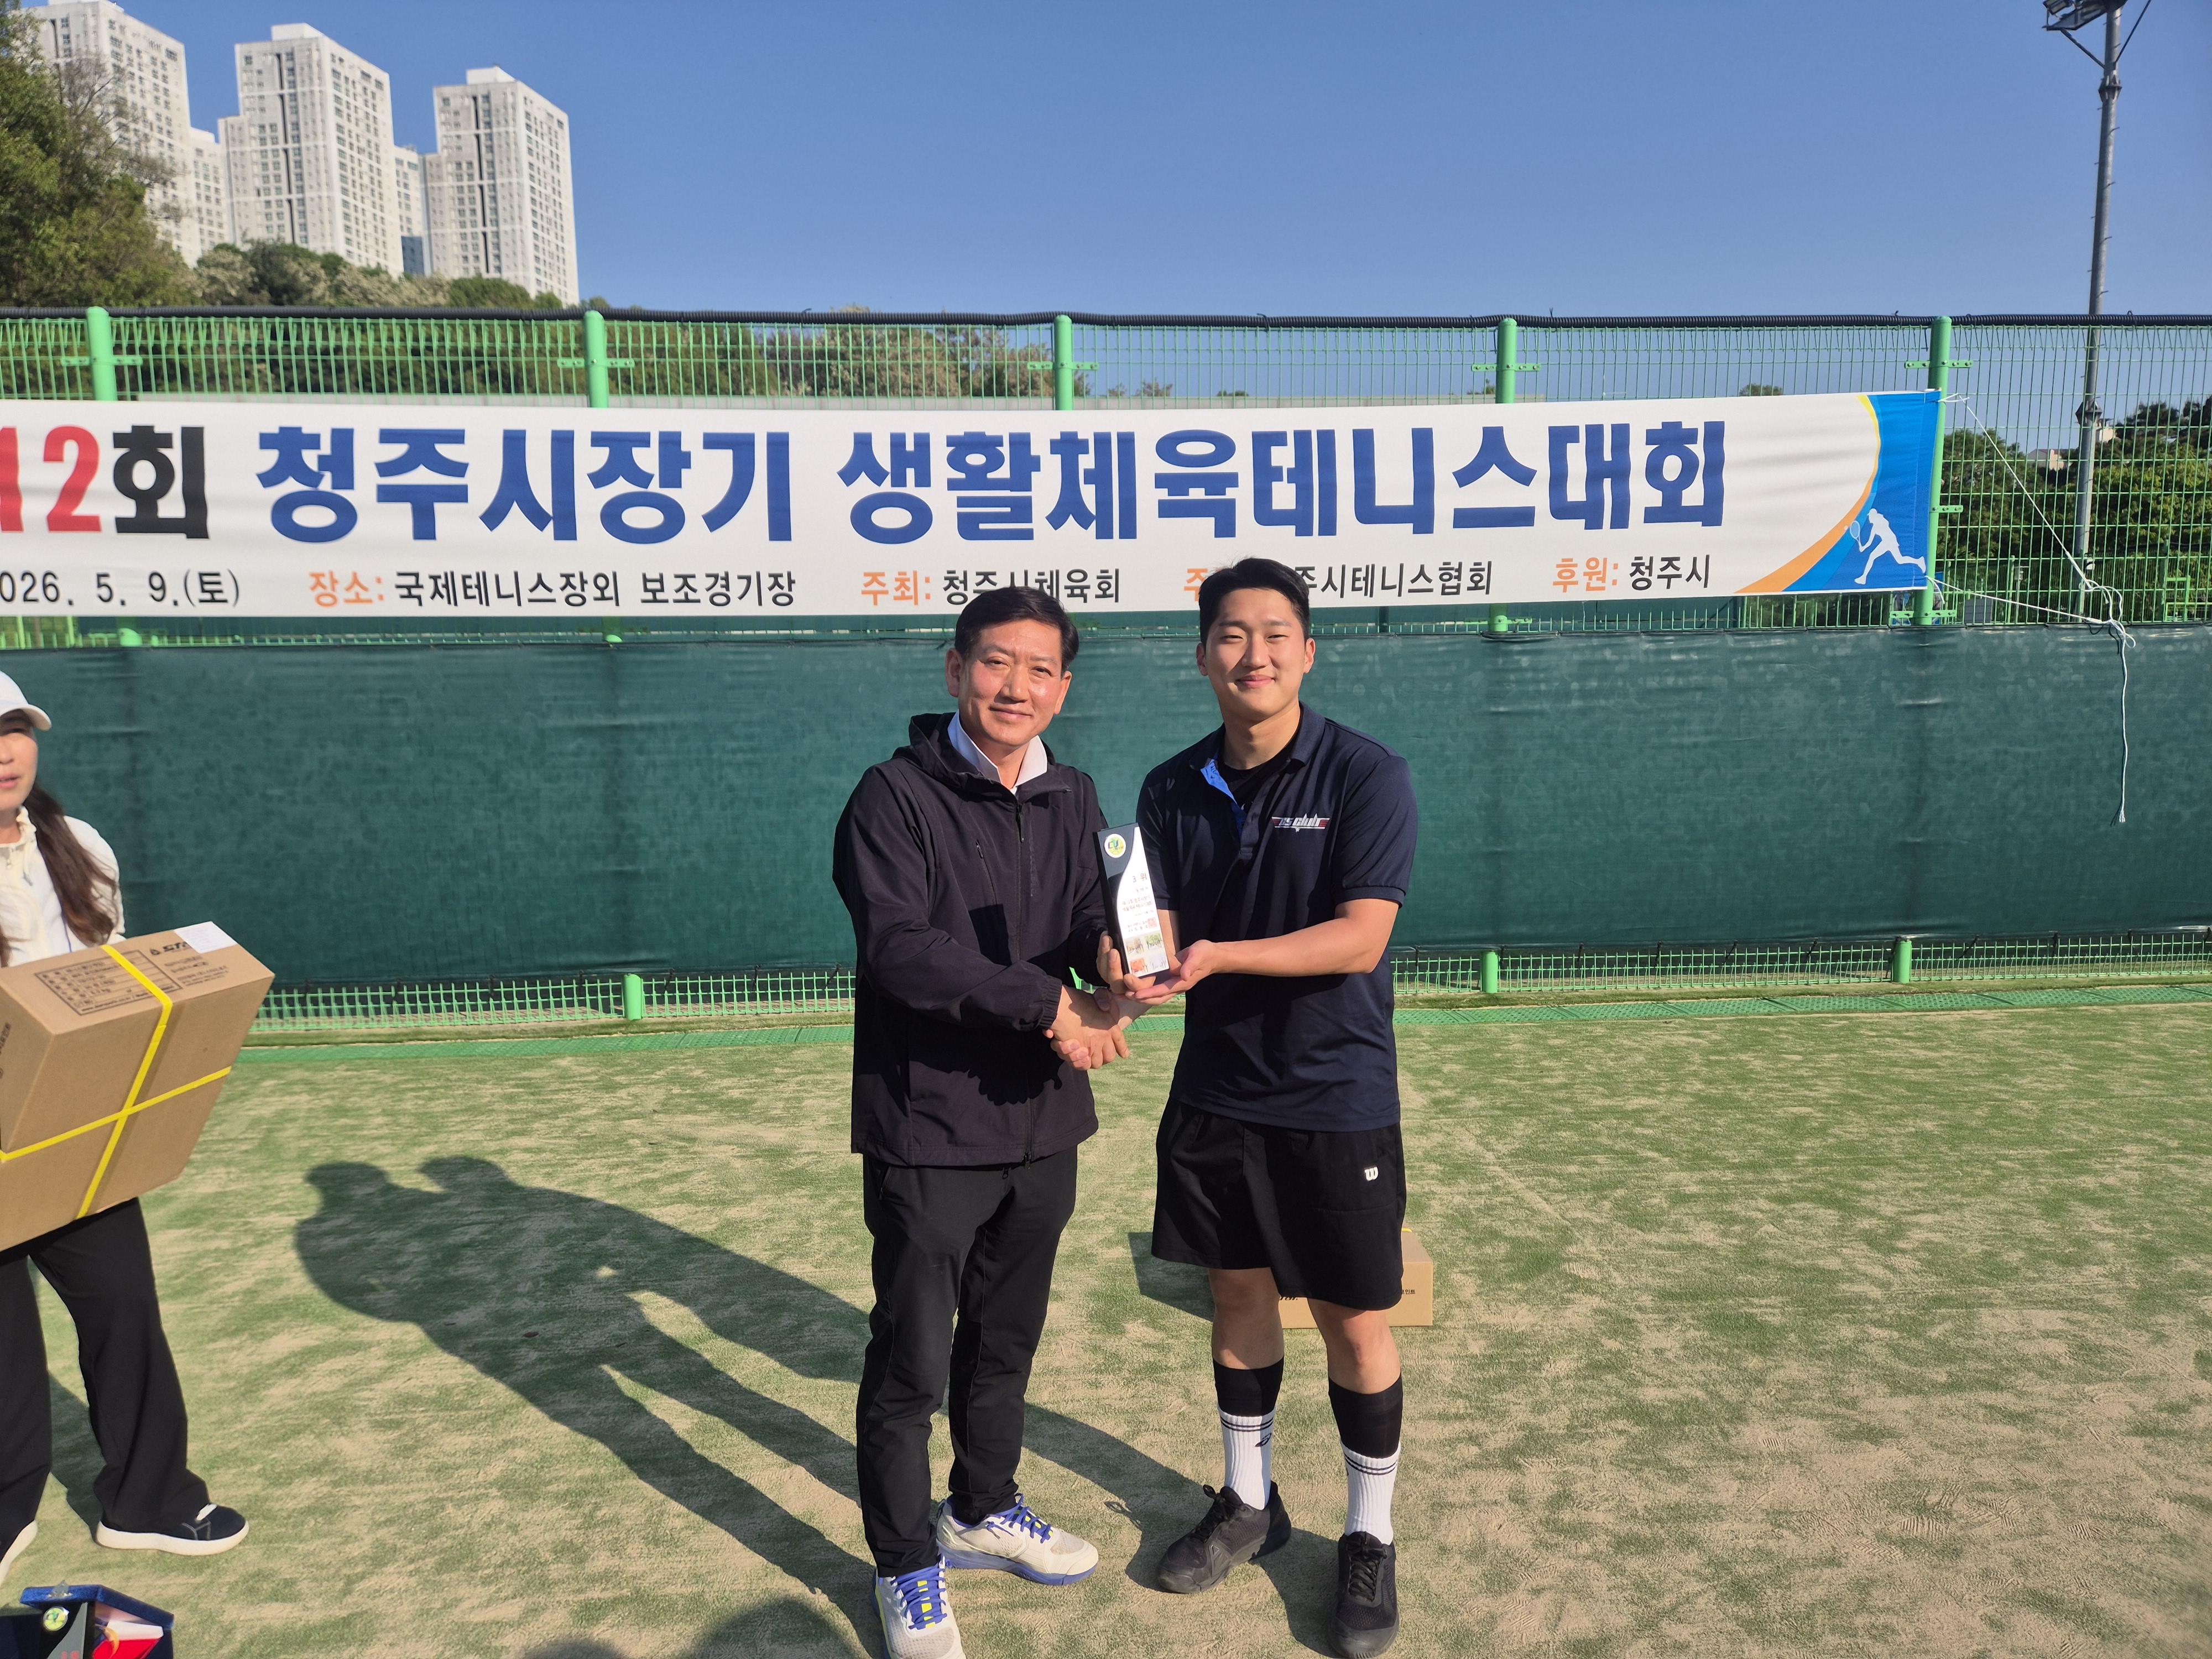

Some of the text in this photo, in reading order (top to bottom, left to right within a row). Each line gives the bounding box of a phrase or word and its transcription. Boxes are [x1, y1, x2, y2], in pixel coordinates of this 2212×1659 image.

[0, 421, 1725, 545] 12회 청주시장기 생활체육테니스대회
[96, 572, 126, 606] 5.
[310, 571, 384, 607] 장소:
[395, 571, 619, 607] 국제테니스장외
[641, 571, 796, 607] 보조경기장
[861, 571, 931, 606] 주최:
[1295, 561, 1492, 599] 주시테니스협회
[1553, 557, 1619, 593] 후원:
[1630, 555, 1710, 591] 청주시
[1140, 873, 1147, 881] 위
